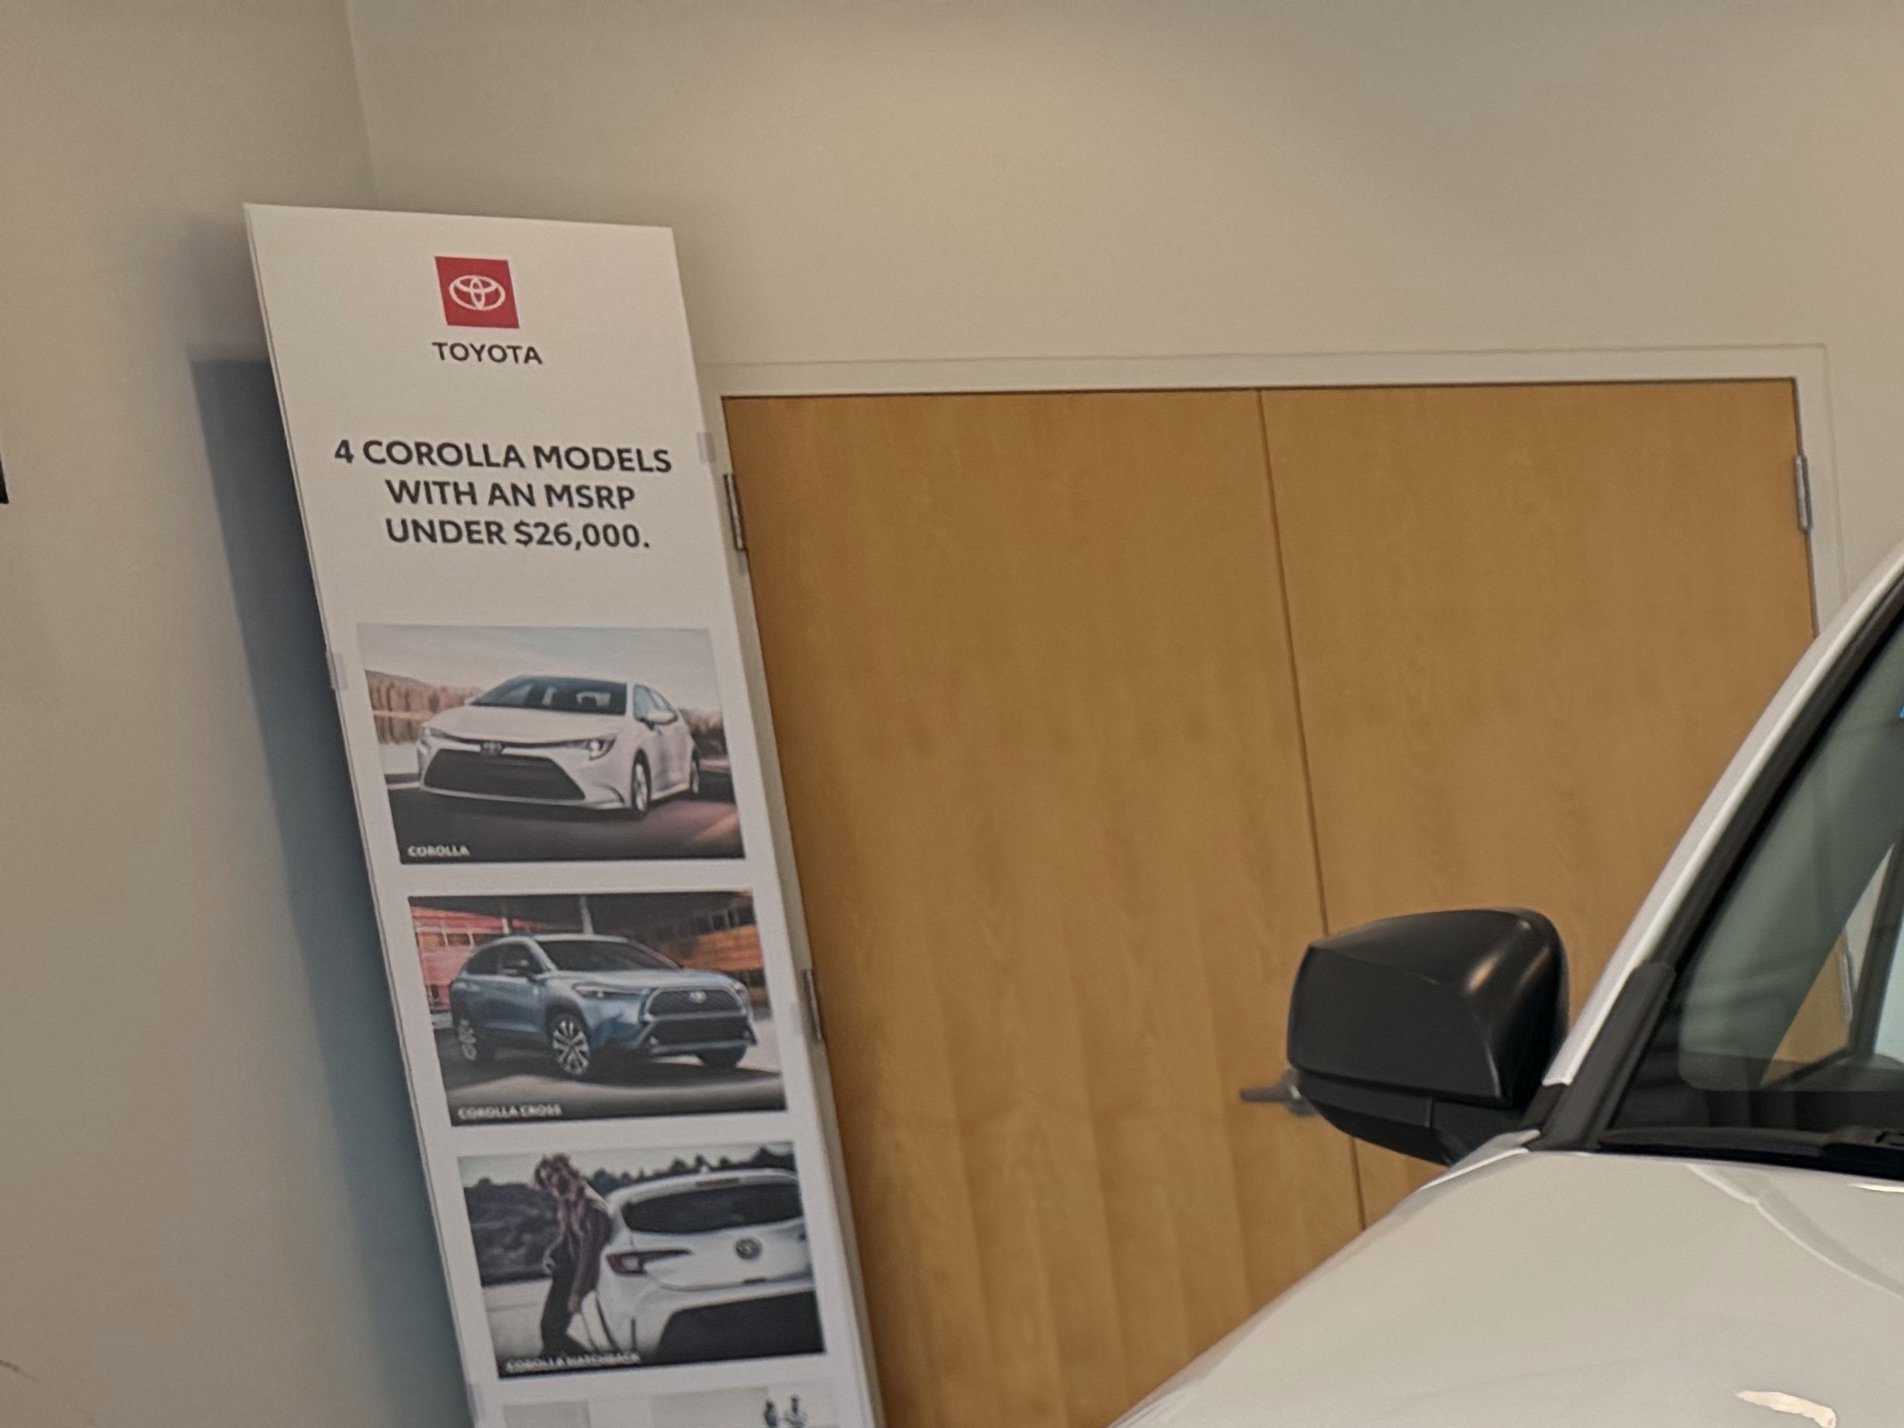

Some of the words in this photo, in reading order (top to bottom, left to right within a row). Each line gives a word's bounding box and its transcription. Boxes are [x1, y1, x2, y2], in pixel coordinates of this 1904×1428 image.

[432, 341, 543, 365] TOYOTA
[334, 439, 355, 464] 4
[362, 440, 526, 469] COROLLA
[532, 445, 672, 473] MODELS
[384, 479, 478, 506] WITH
[487, 482, 537, 507] AN
[544, 484, 635, 509] MSRP
[385, 517, 507, 545] UNDER
[514, 519, 650, 551] $26,000.
[407, 845, 470, 858] COROLLA
[457, 1105, 518, 1120] COROLLA
